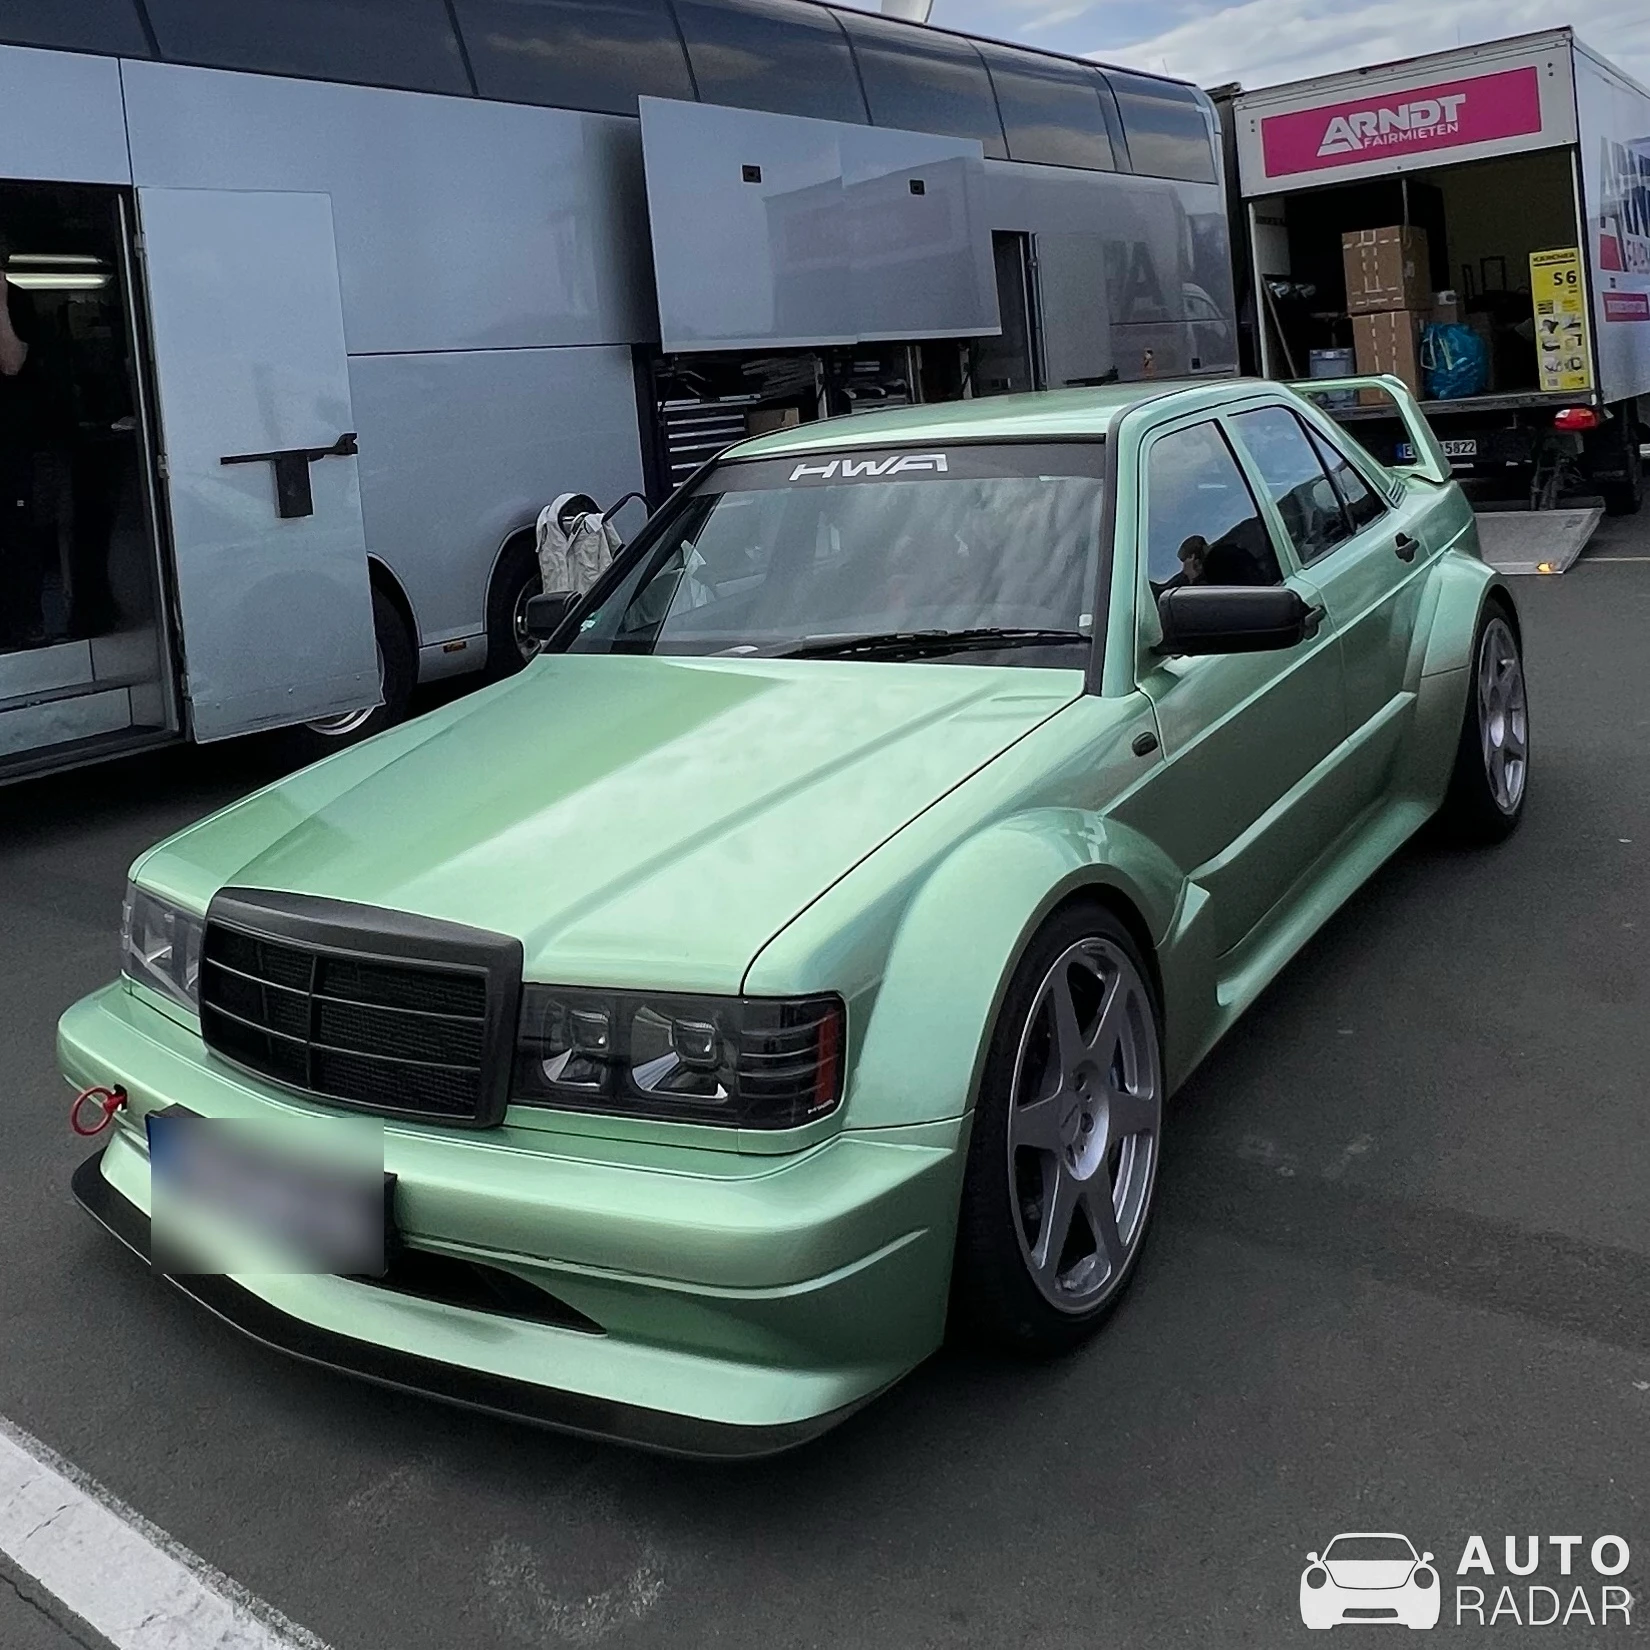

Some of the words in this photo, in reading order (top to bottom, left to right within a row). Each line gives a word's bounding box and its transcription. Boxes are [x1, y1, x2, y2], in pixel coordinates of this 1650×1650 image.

[1316, 93, 1466, 157] ARNDT
[1363, 122, 1459, 149] FAIRMIETEN
[788, 453, 949, 482] HWA
